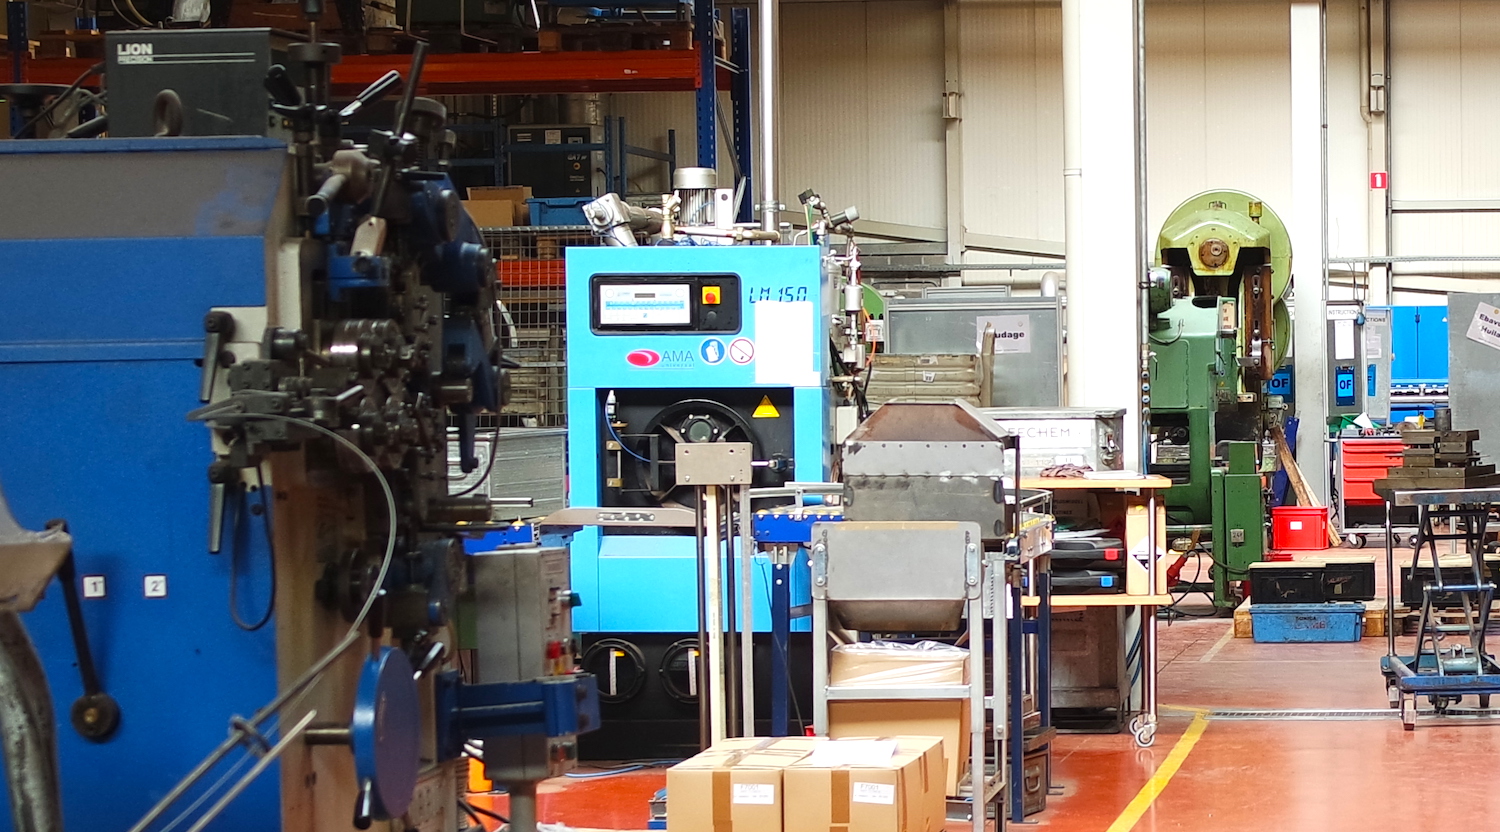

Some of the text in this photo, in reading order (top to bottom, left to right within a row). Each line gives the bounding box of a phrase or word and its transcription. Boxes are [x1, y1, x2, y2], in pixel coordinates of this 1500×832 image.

[117, 43, 154, 55] LION
[1374, 173, 1382, 188] 1
[778, 286, 807, 303] 150
[994, 331, 1025, 340] udage
[661, 350, 694, 363] AMA
[1271, 378, 1289, 389] OF
[1339, 379, 1352, 390] OF
[151, 580, 159, 592] 2
